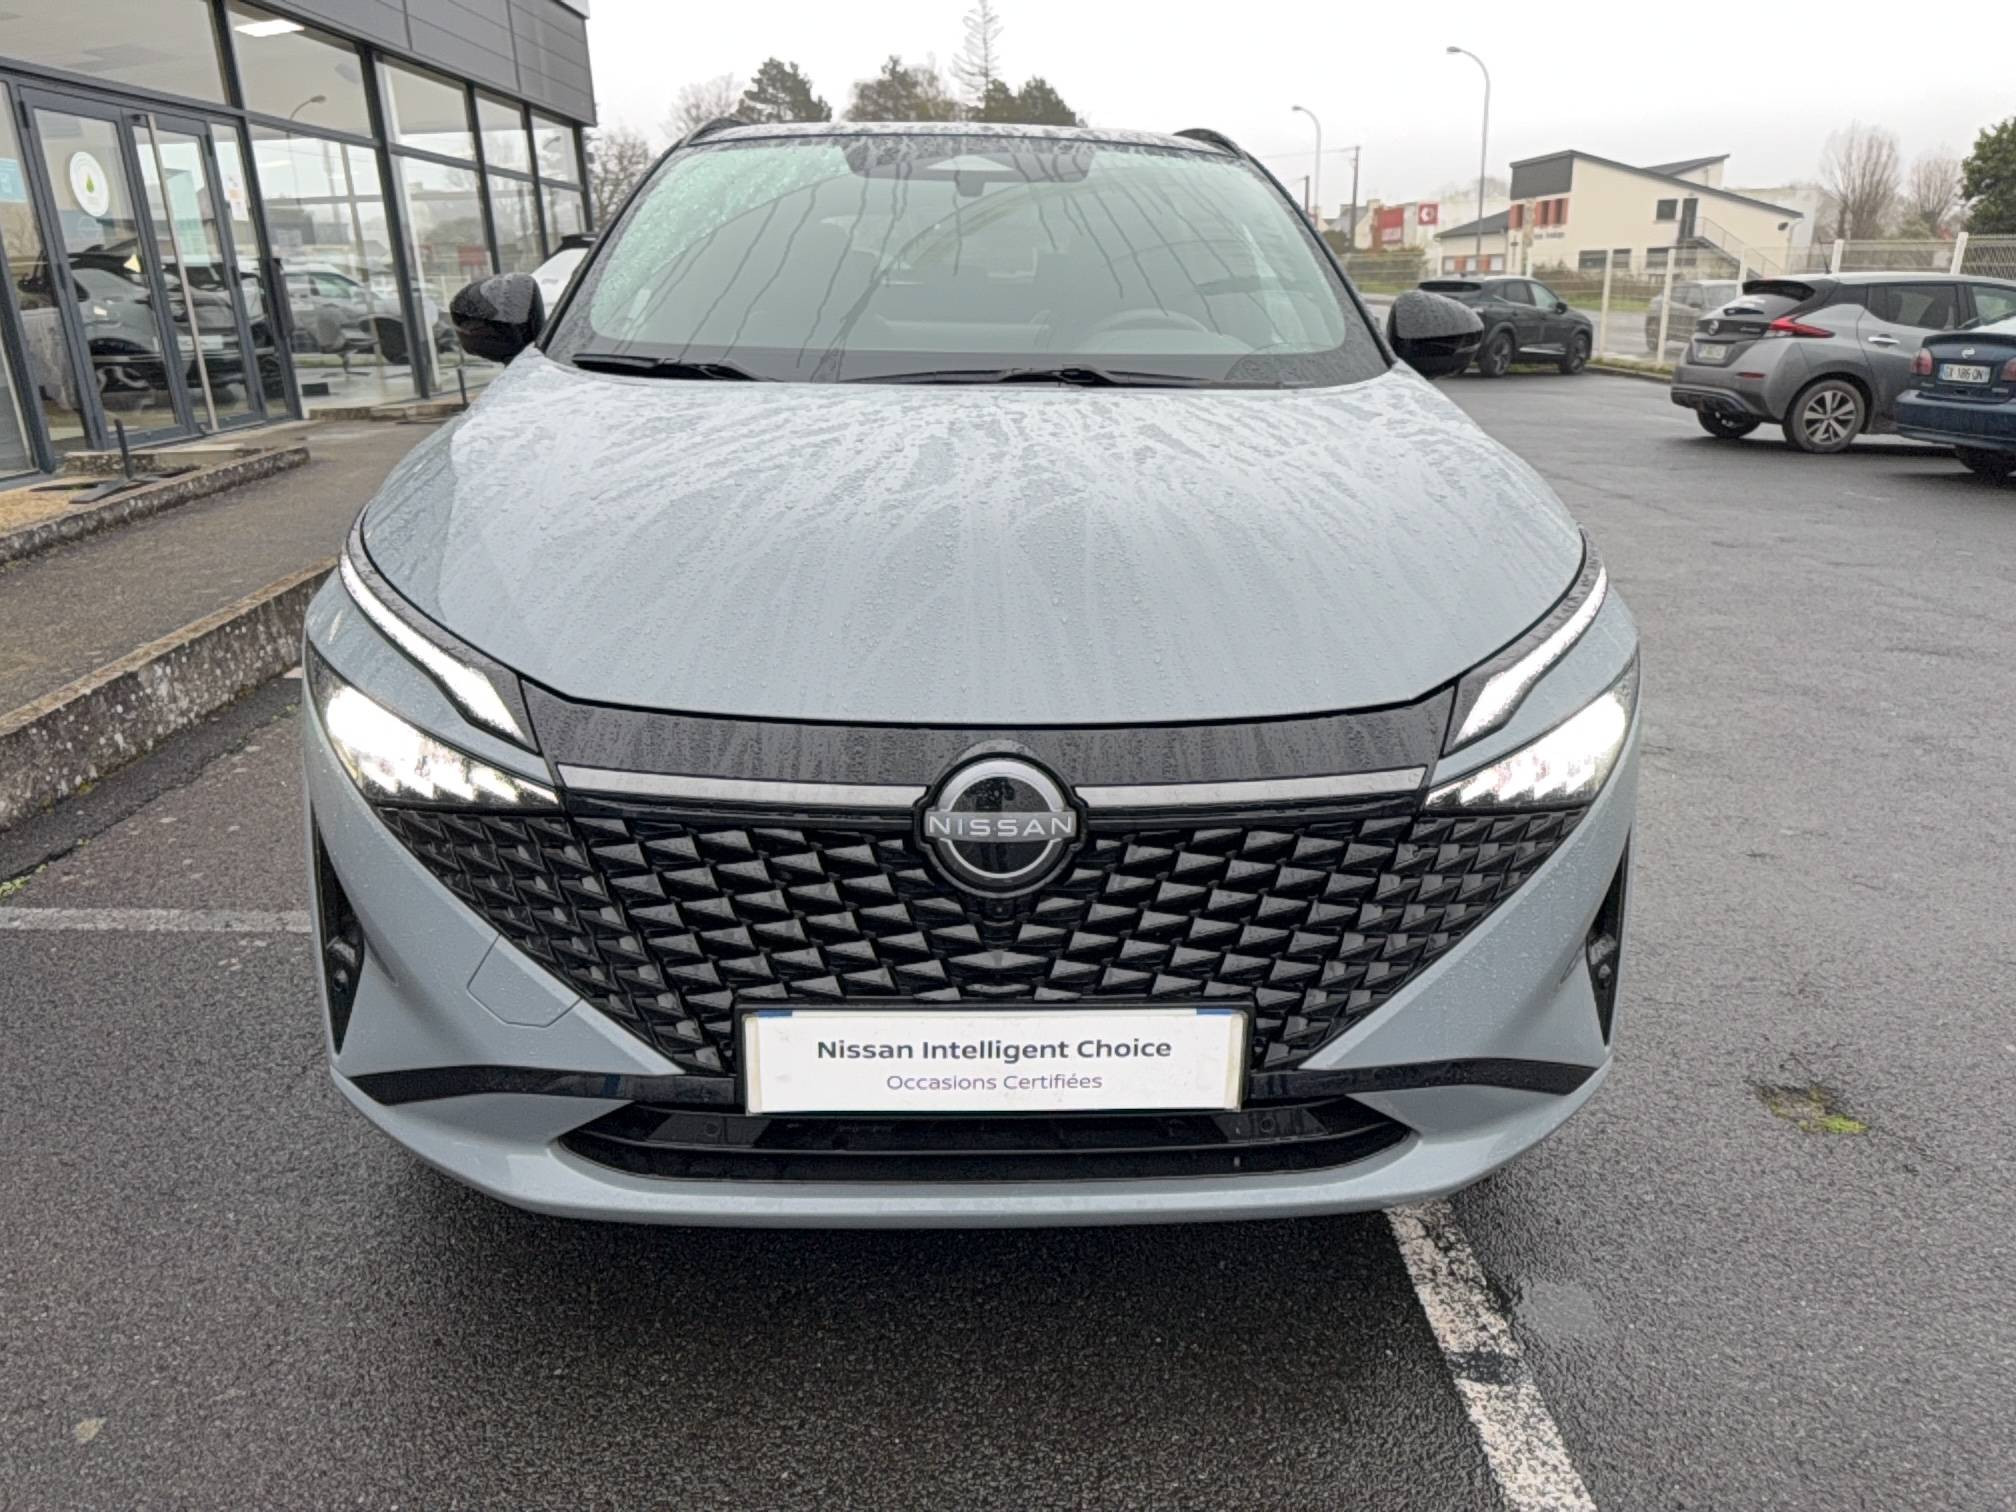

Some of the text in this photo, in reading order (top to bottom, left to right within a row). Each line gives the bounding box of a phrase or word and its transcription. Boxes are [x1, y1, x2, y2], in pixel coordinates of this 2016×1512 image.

[928, 815, 1073, 837] NISSAN
[817, 1038, 1172, 1064] Nissan Intelligent Choice
[886, 1073, 1103, 1091] Occasions Certifiées
